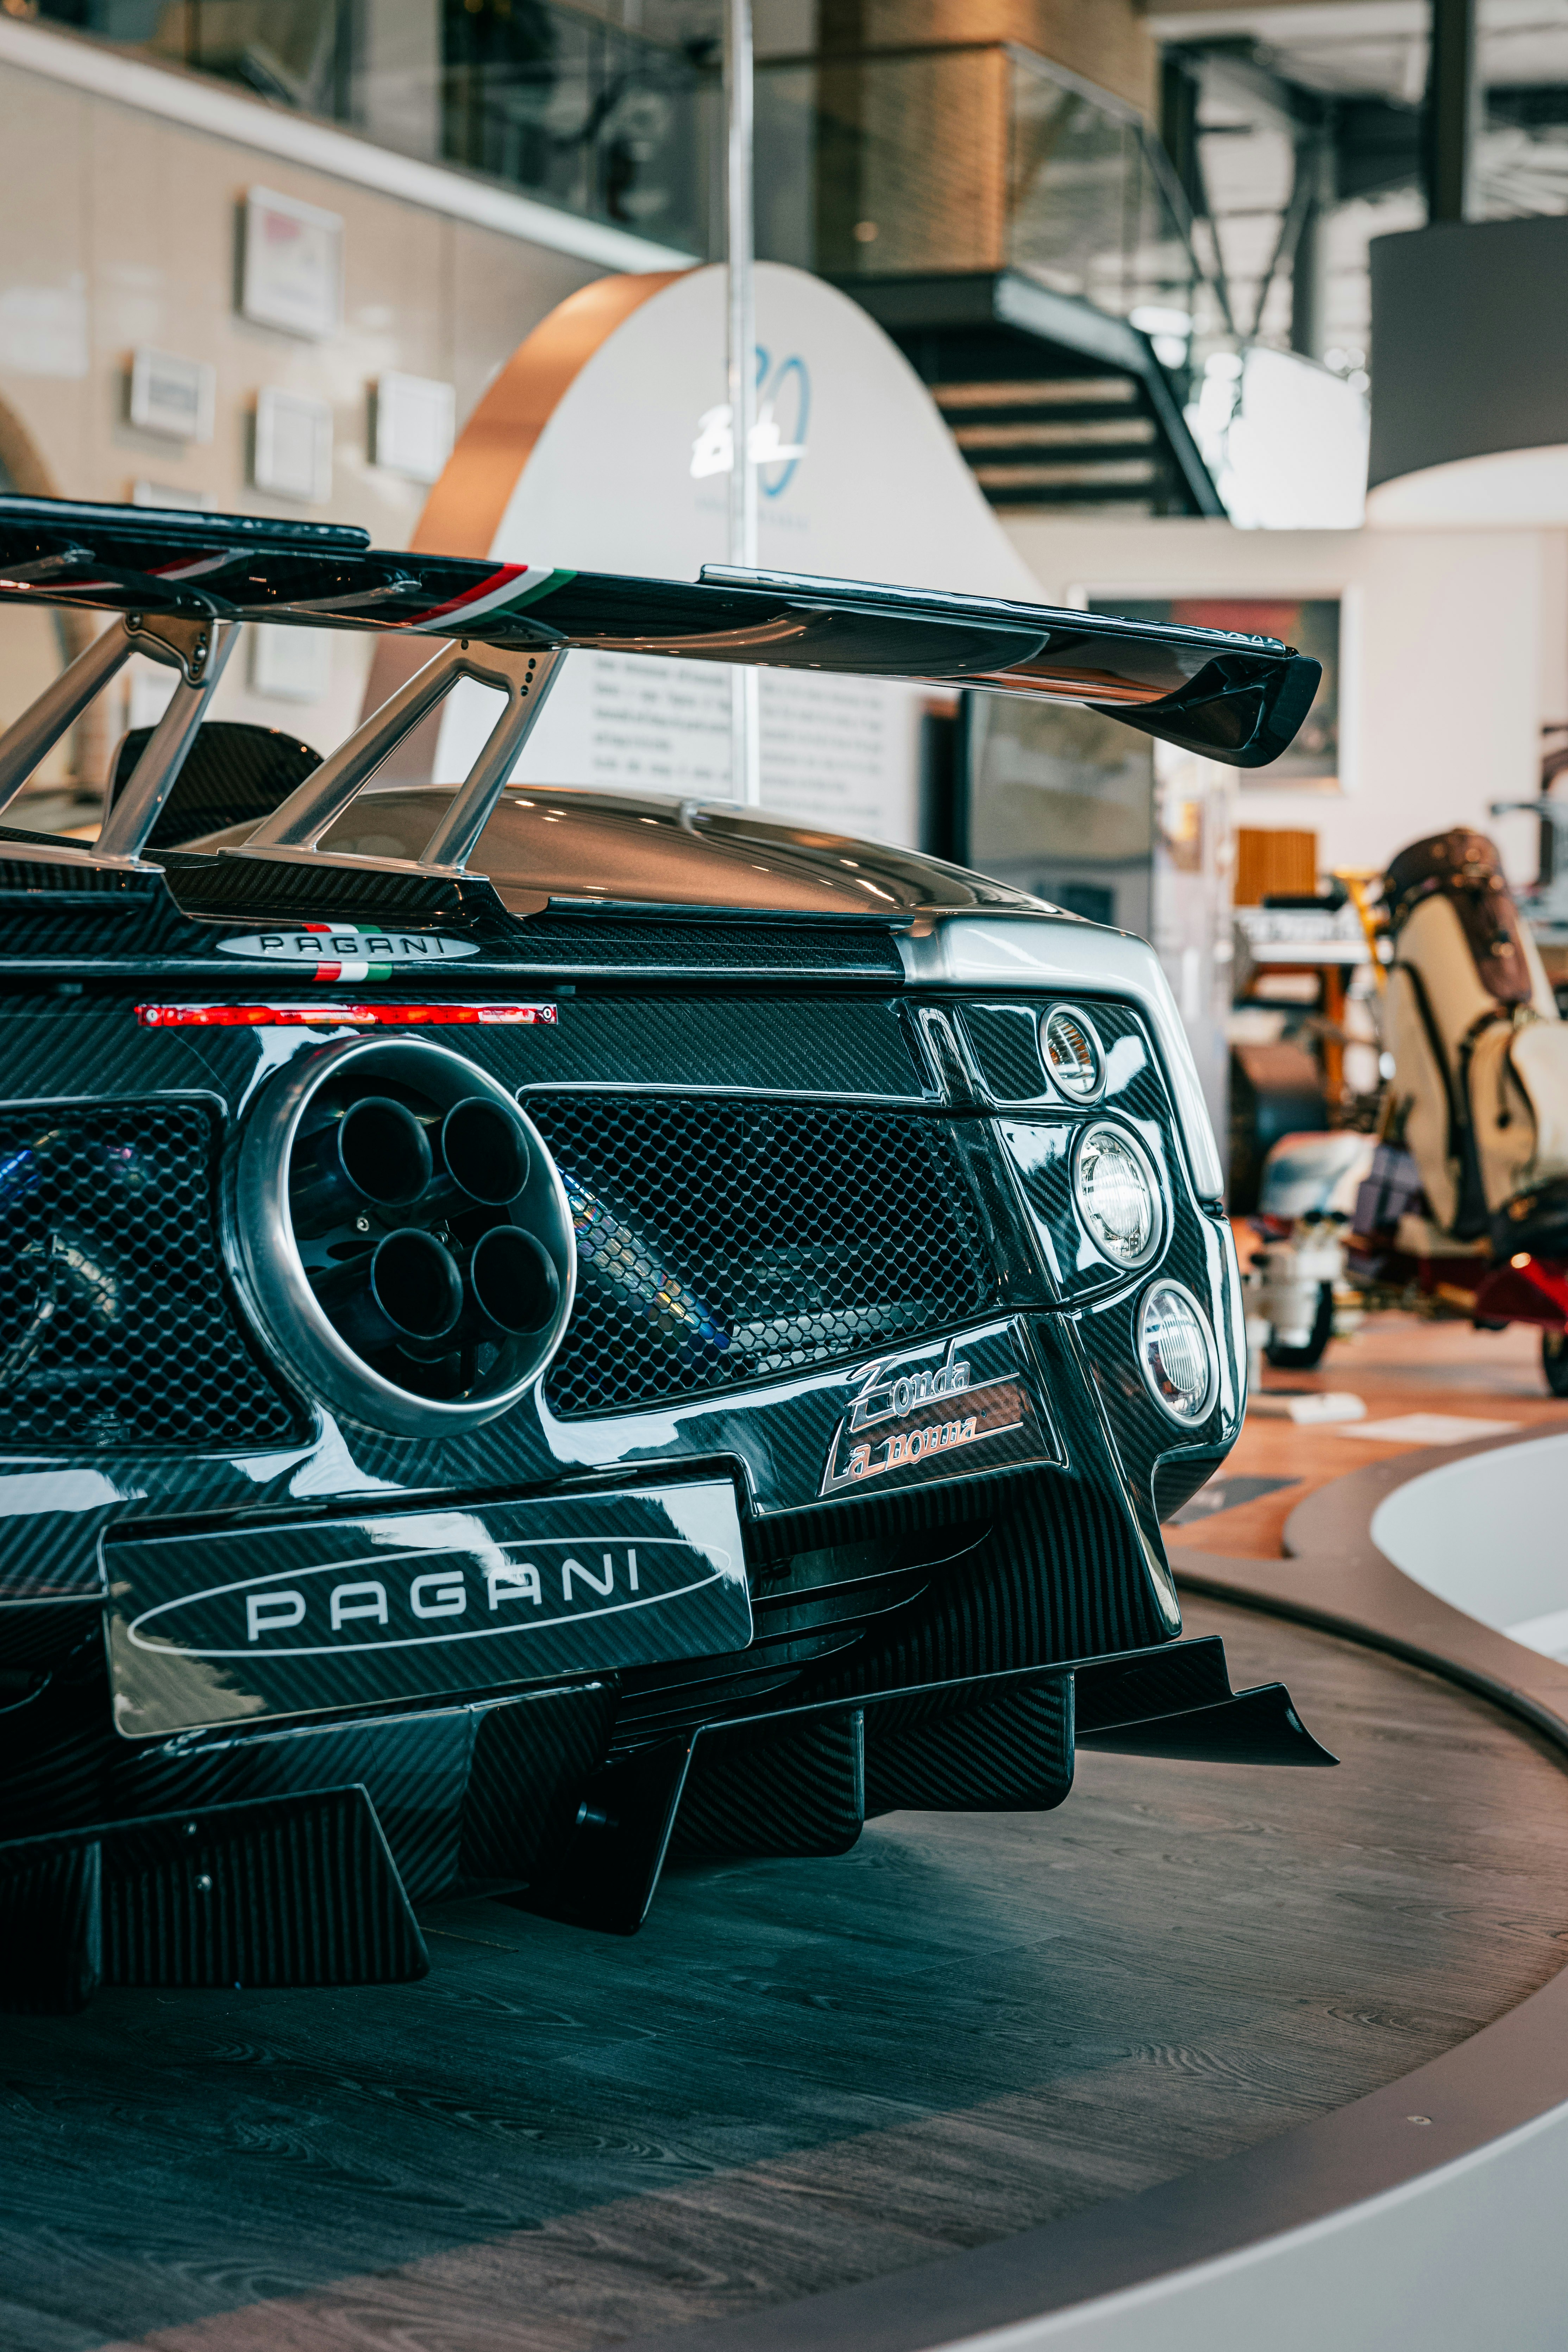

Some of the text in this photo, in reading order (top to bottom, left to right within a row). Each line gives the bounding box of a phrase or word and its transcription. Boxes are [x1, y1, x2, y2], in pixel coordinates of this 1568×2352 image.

[260, 936, 445, 955] PAGANI
[845, 1338, 1020, 1432] Zonda
[818, 1416, 886, 1496] La
[246, 1549, 639, 1642] PAGANI
